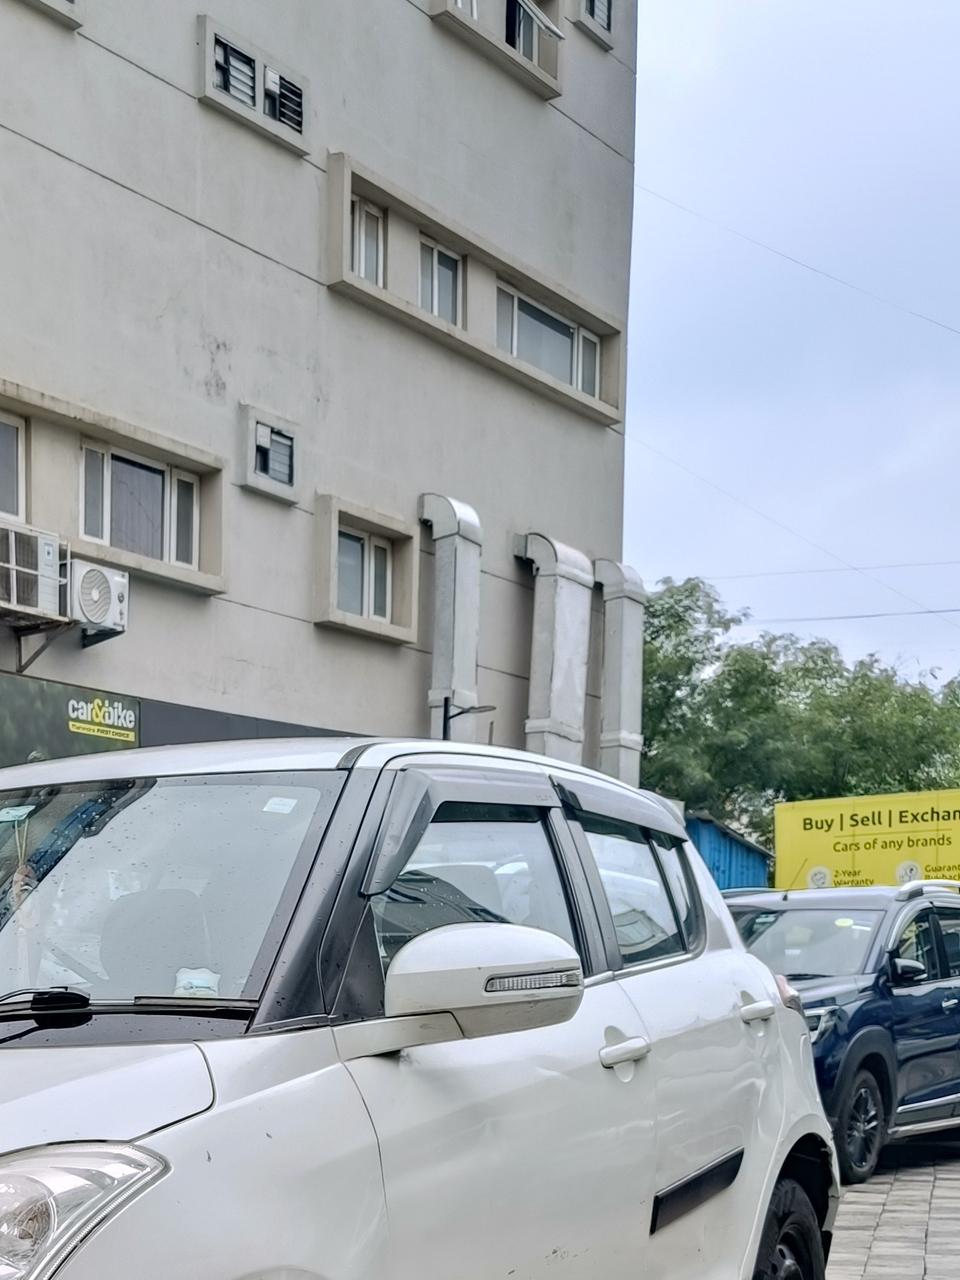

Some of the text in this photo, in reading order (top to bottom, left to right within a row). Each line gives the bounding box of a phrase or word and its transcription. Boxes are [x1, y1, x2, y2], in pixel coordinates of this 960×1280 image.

[68, 698, 135, 728] car&bike
[803, 817, 834, 833] Buy
[849, 810, 882, 828] Sell
[899, 807, 960, 824] Exchan
[833, 834, 952, 853] Cars of any brands
